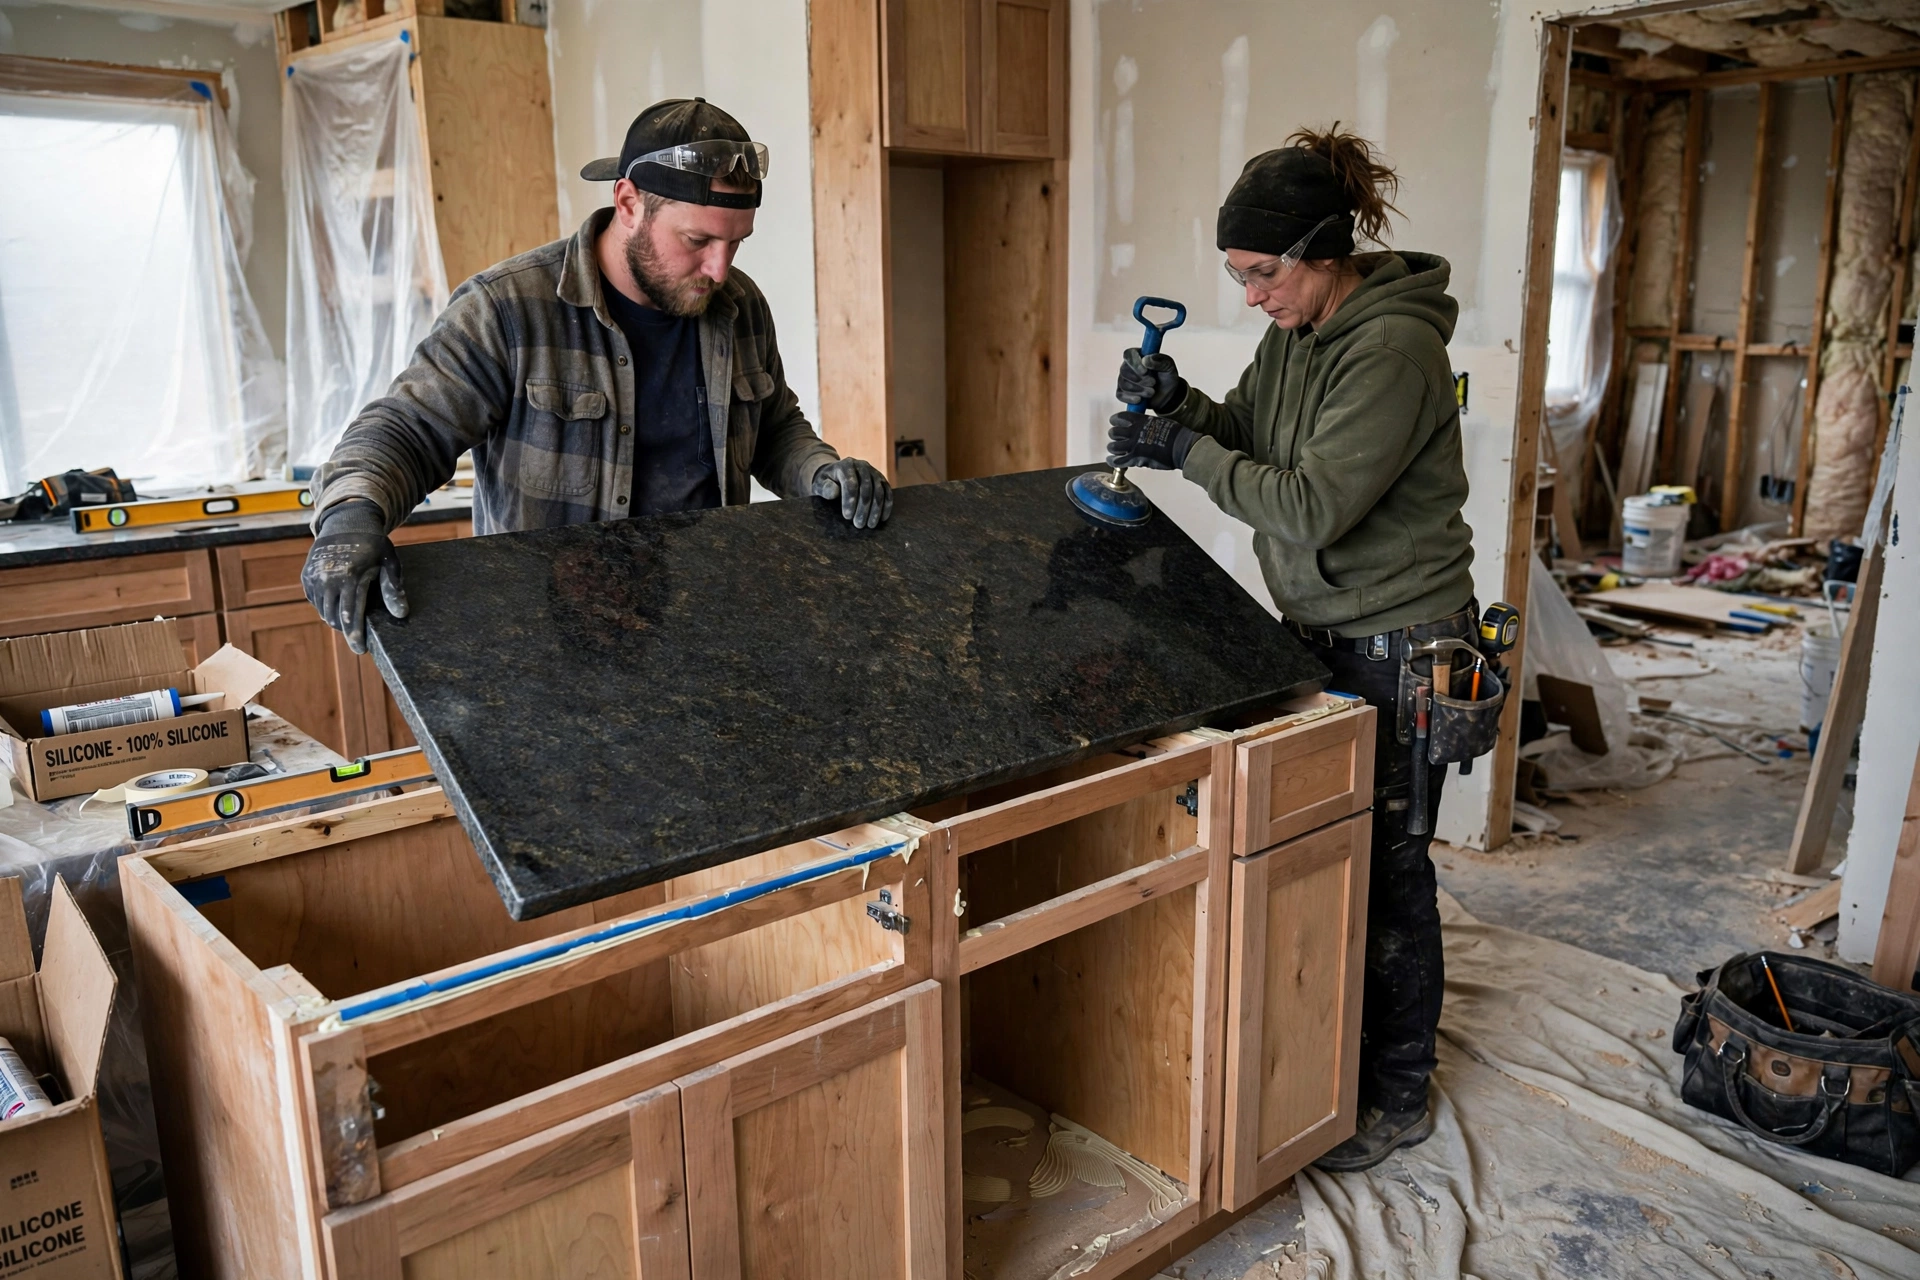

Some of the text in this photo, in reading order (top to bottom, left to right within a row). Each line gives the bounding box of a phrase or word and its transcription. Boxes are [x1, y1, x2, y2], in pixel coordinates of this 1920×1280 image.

[45, 740, 114, 767] SILICONE
[126, 732, 163, 754] 100%
[167, 720, 228, 746] SILICONE
[0, 1200, 84, 1245] ILICONE
